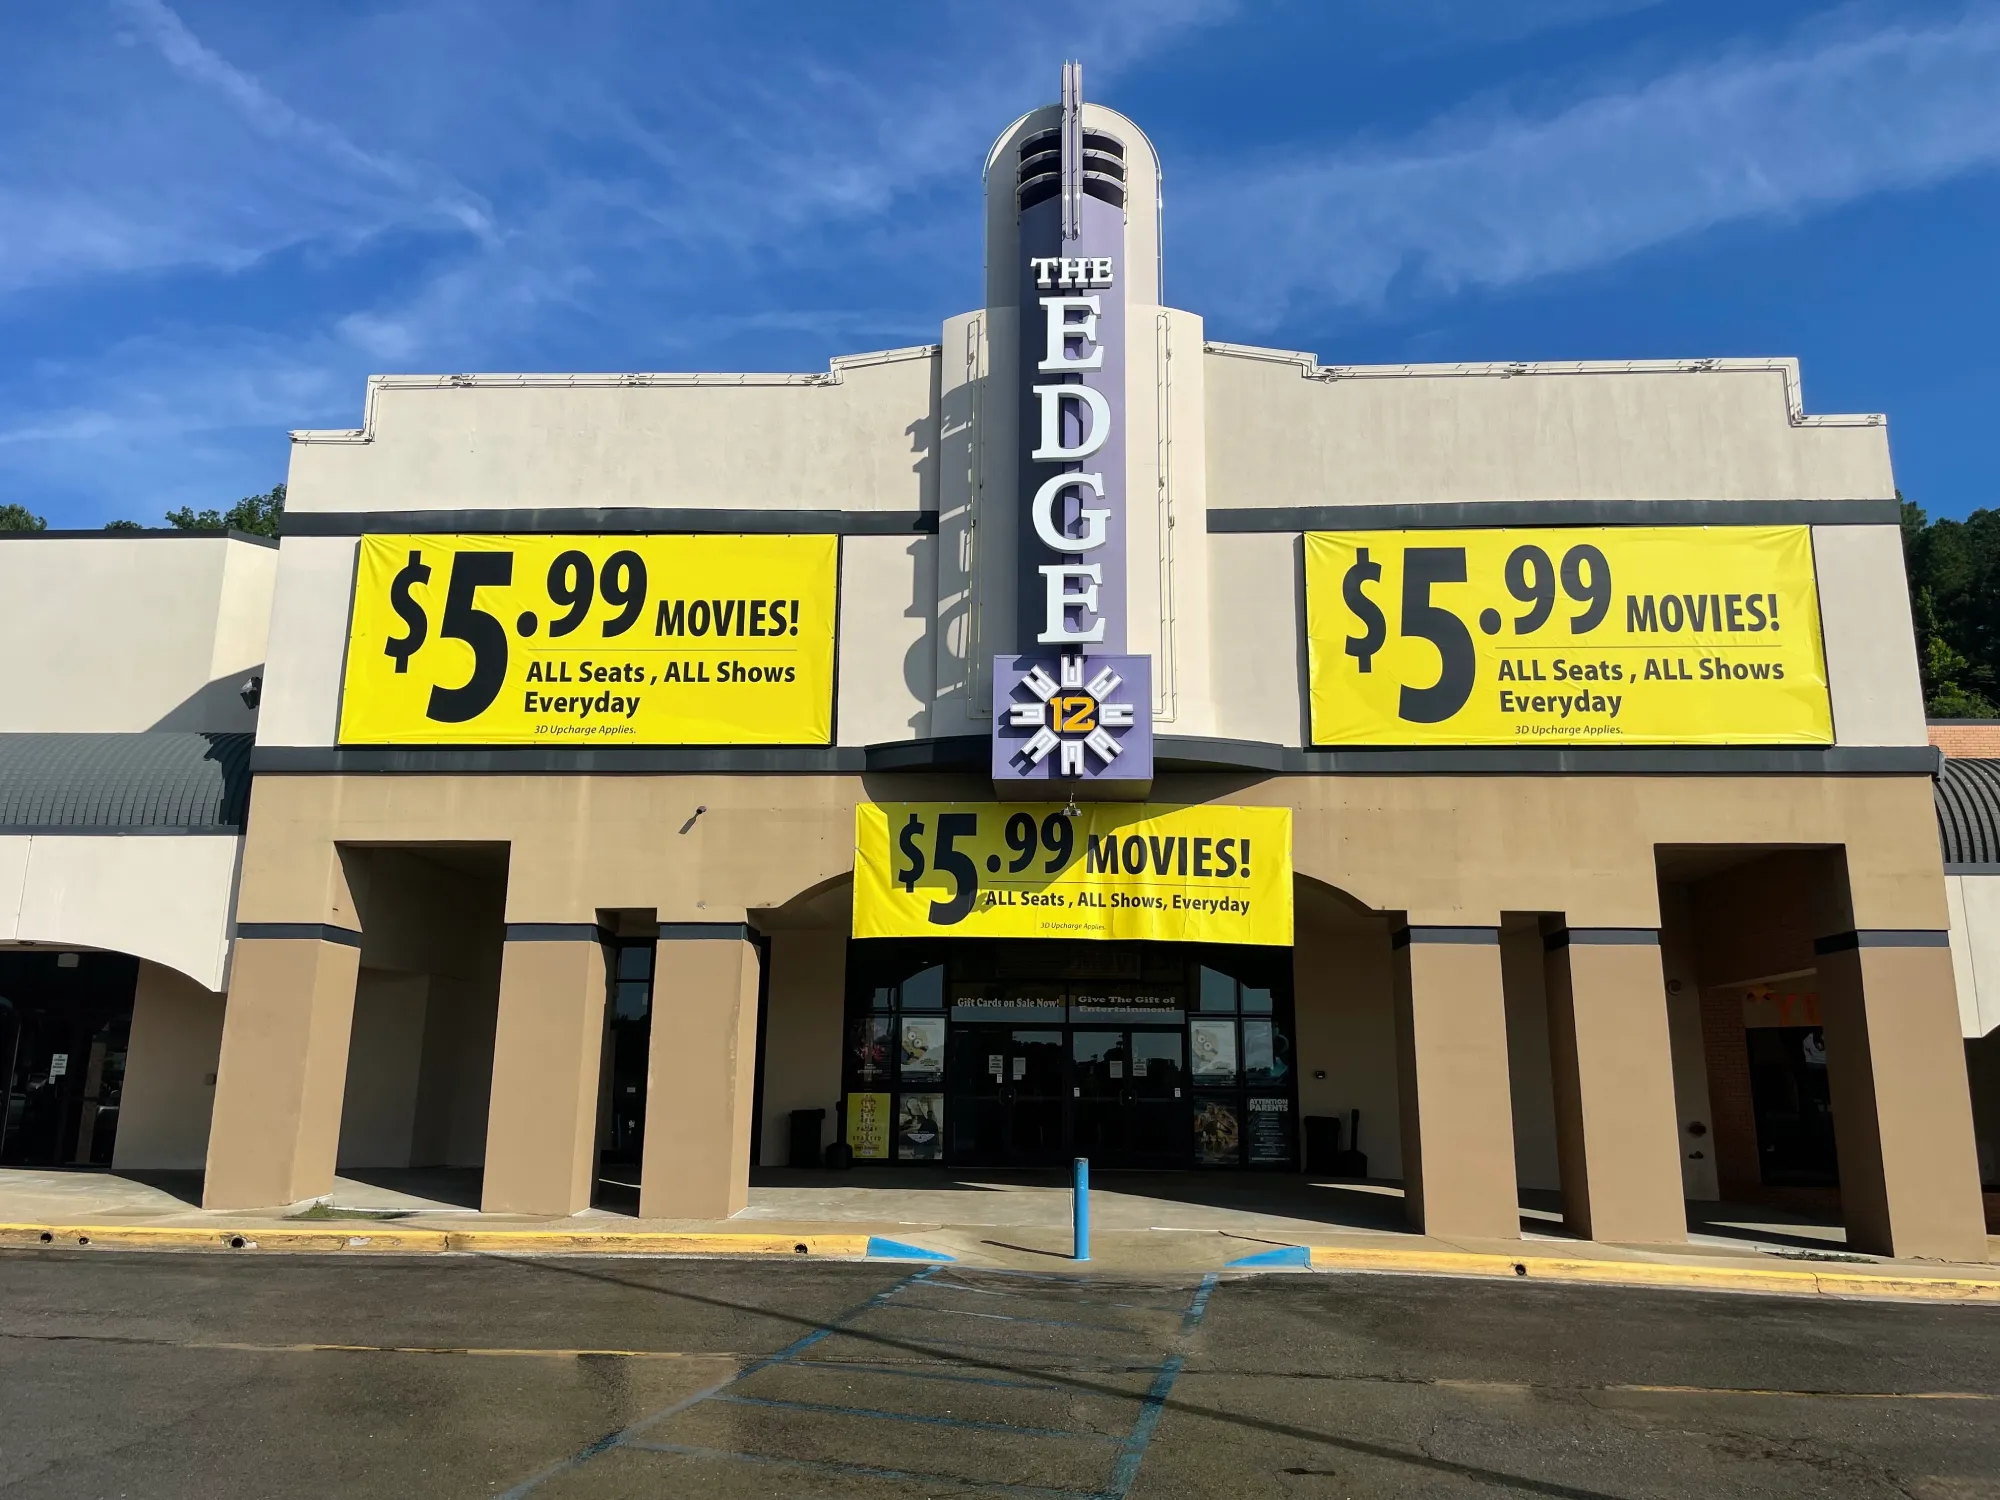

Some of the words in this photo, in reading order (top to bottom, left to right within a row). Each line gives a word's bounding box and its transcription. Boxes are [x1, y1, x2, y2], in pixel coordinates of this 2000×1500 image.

[1030, 257, 1113, 289] THE
[1031, 295, 1111, 644] EDGE
[384, 550, 647, 723] $5.99
[655, 600, 799, 636] MOVIES!
[1343, 544, 1612, 723] $5.99
[1627, 594, 1779, 632] MOVIES!
[526, 662, 572, 682] ALL
[664, 662, 709, 682] ALL
[717, 661, 795, 682] Shows
[1498, 660, 1546, 681] ALL
[1644, 659, 1692, 680] ALL
[1699, 657, 1784, 680] Shows
[525, 691, 640, 719] Everyday
[1050, 696, 1095, 733] 12
[1500, 689, 1621, 718] Everyday
[535, 725, 548, 733] 3D
[550, 725, 596, 736] Upcharge
[599, 725, 635, 735] Applies.
[1516, 726, 1529, 734] 3D
[1532, 725, 1580, 735] Upcharge
[1584, 725, 1623, 735] Applies.
[899, 812, 1074, 925] $5.99
[1086, 833, 1250, 878] MOVIES!
[985, 891, 1017, 907] ALL
[1078, 892, 1106, 907] ALL
[1111, 893, 1167, 910] Shows,
[1173, 895, 1250, 916] Everyday
[957, 997, 976, 1008] Gift
[978, 997, 1002, 1008] Cards
[1004, 1000, 1015, 1008] on
[1016, 998, 1035, 1008] Sale
[1037, 998, 1060, 1009] Now!
[1078, 996, 1105, 1004] Give
[1109, 996, 1132, 1004] The
[1135, 996, 1159, 1004] Gift
[1162, 996, 1176, 1004] of
[1250, 1104, 1288, 1112] PARENTS
